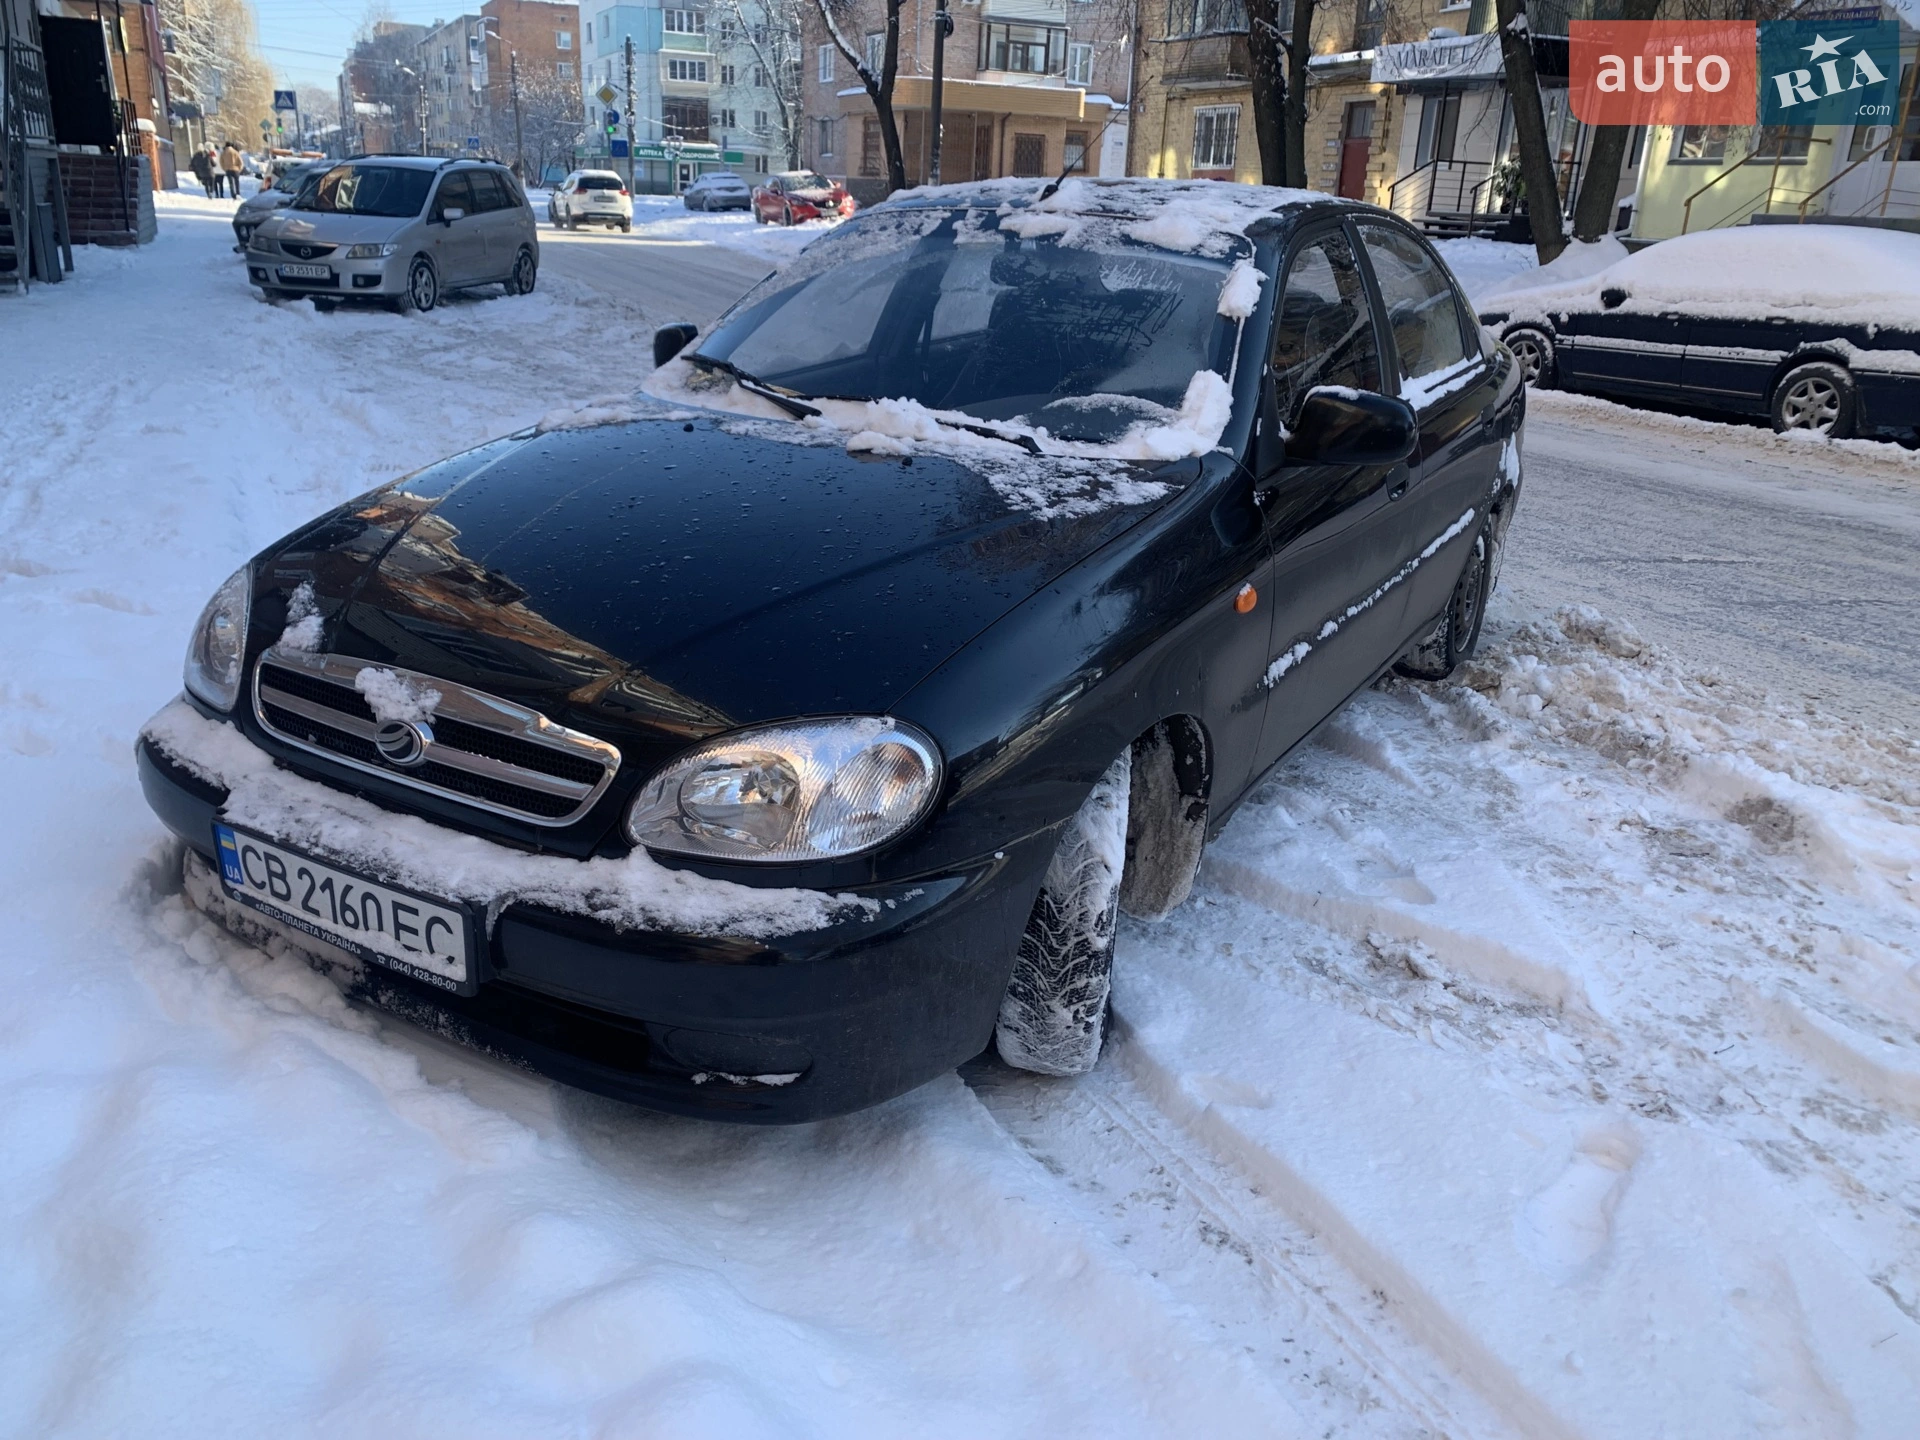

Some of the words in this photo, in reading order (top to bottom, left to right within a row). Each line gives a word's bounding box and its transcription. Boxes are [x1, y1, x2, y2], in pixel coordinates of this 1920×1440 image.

[639, 149, 663, 157] АПТЕКА
[225, 864, 242, 882] UA
[390, 958, 411, 975] (044)
[413, 968, 457, 991] 428-80-00
